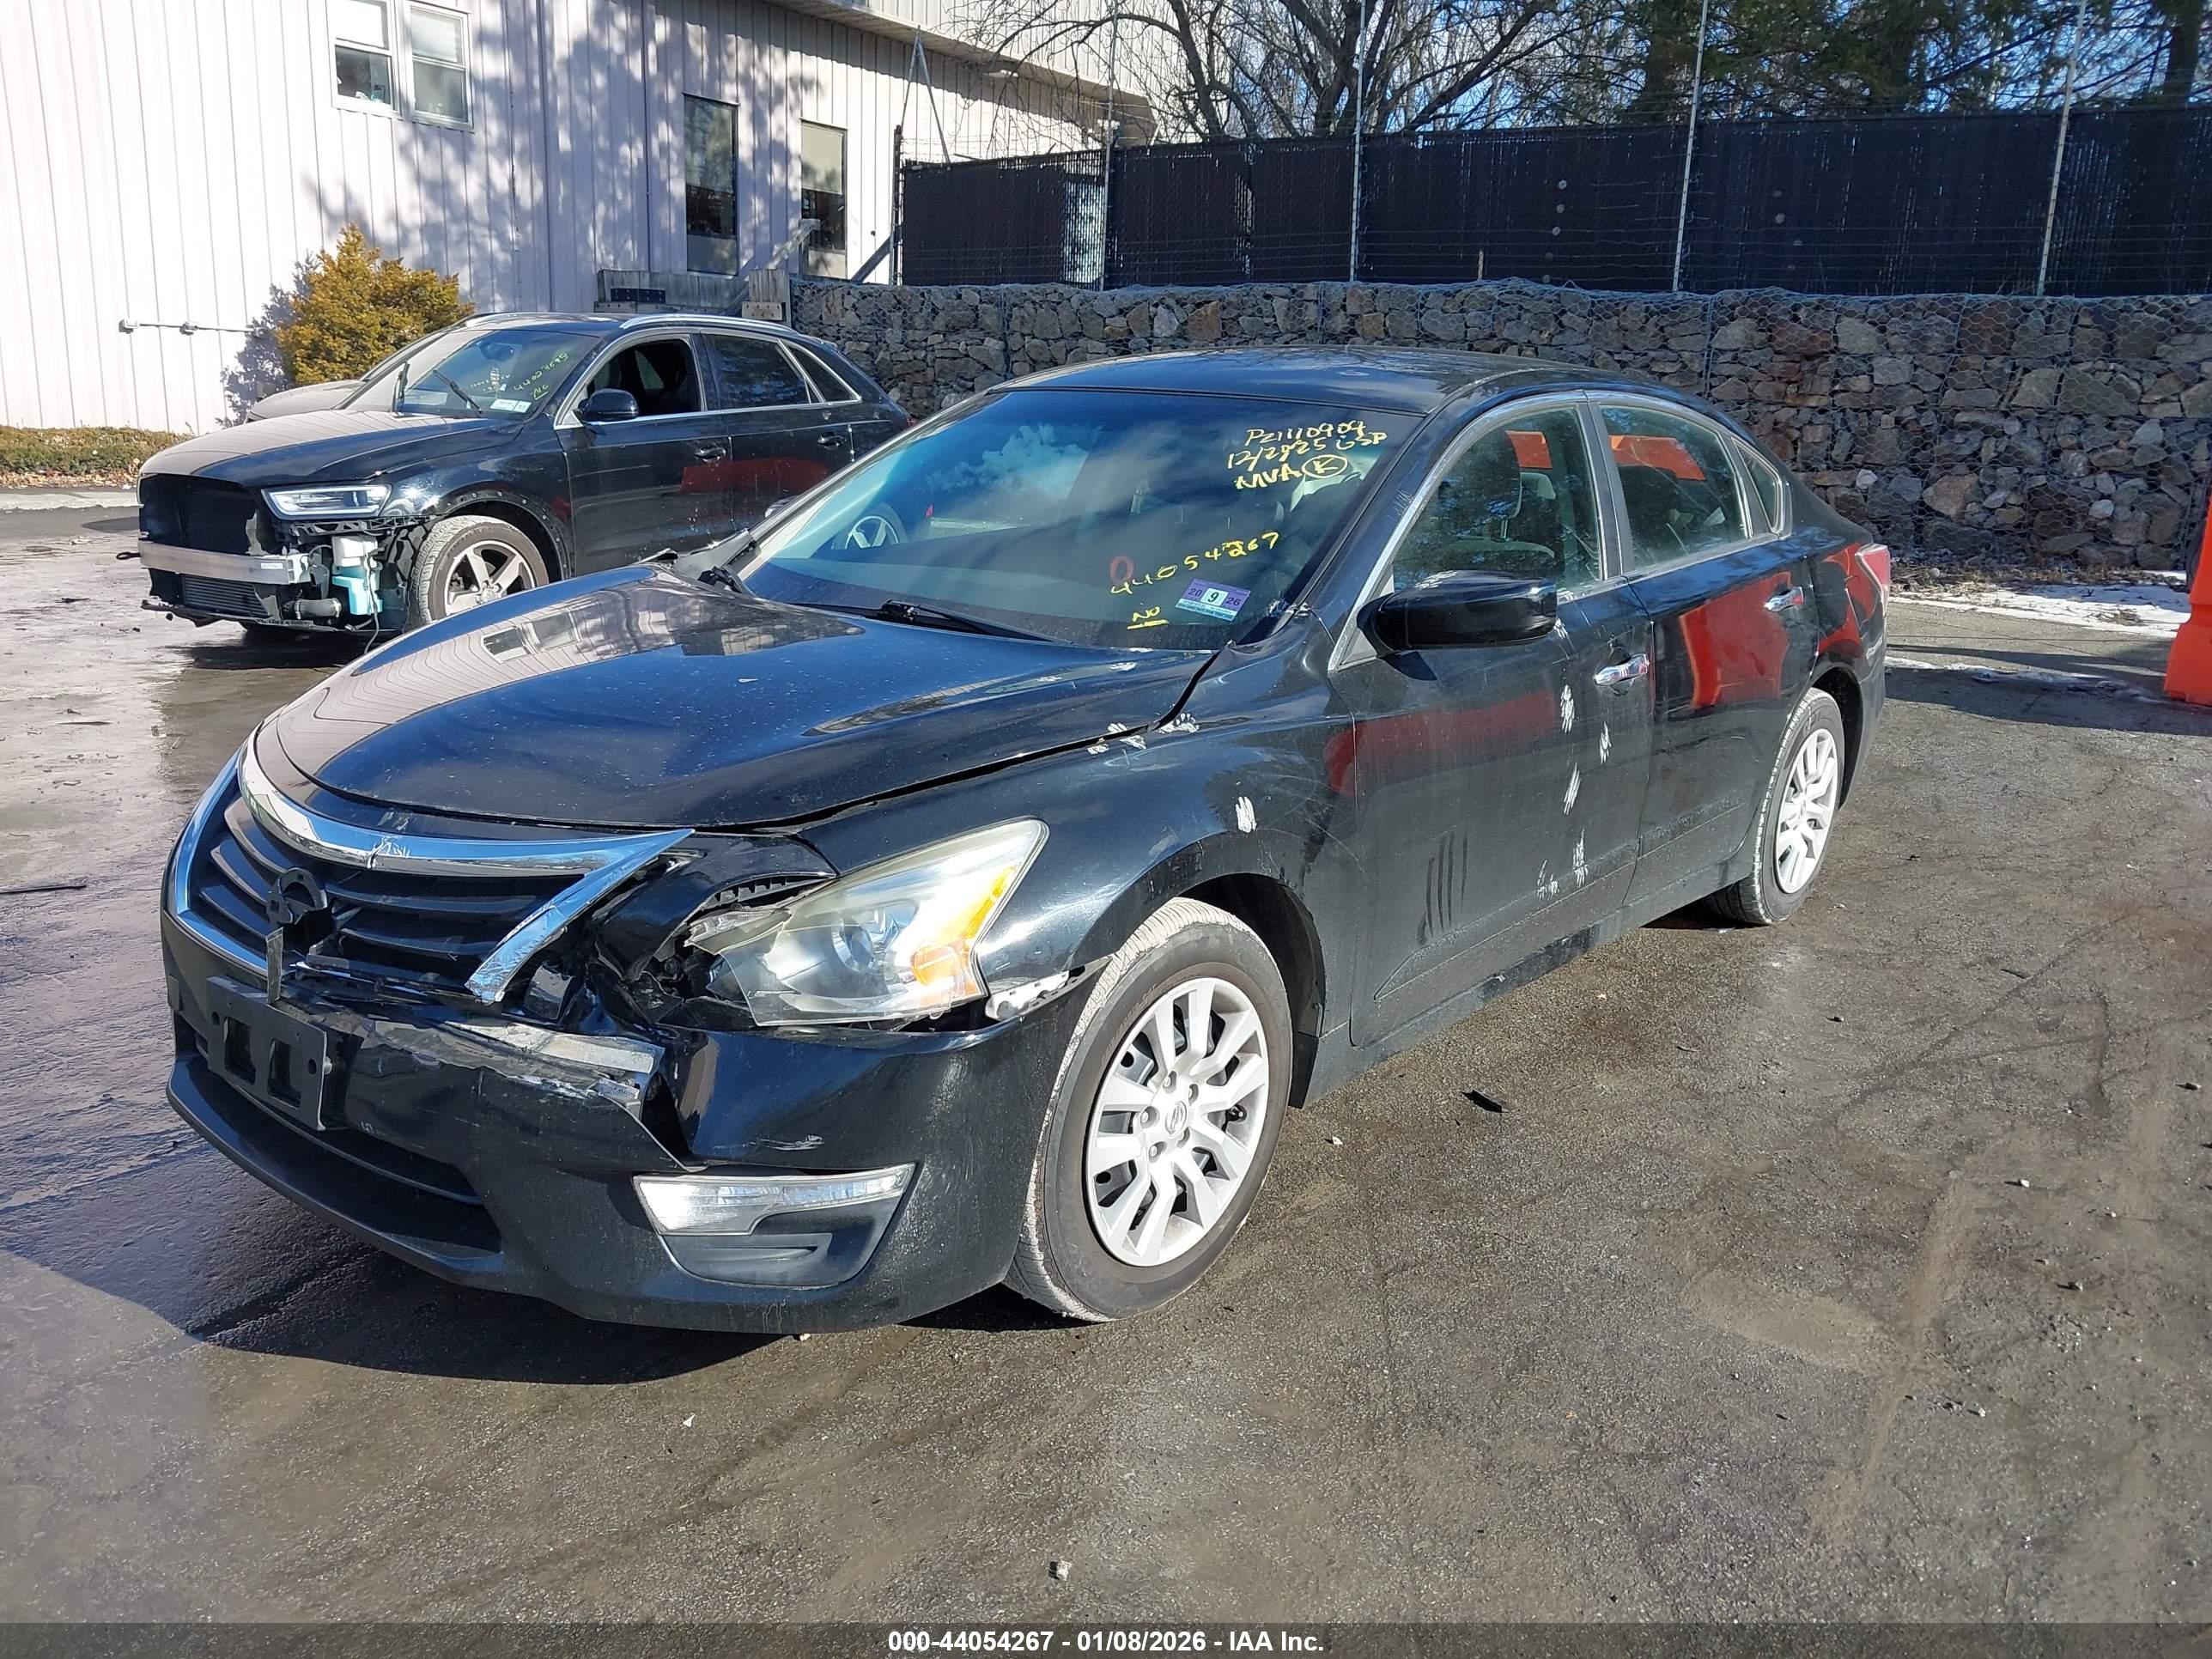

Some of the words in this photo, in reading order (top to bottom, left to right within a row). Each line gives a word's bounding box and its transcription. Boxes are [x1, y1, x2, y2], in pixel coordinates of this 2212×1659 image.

[1234, 462, 1304, 490] MVA
[1188, 587, 1203, 597] 20
[1206, 591, 1219, 603] 9
[1224, 596, 1242, 606] 26
